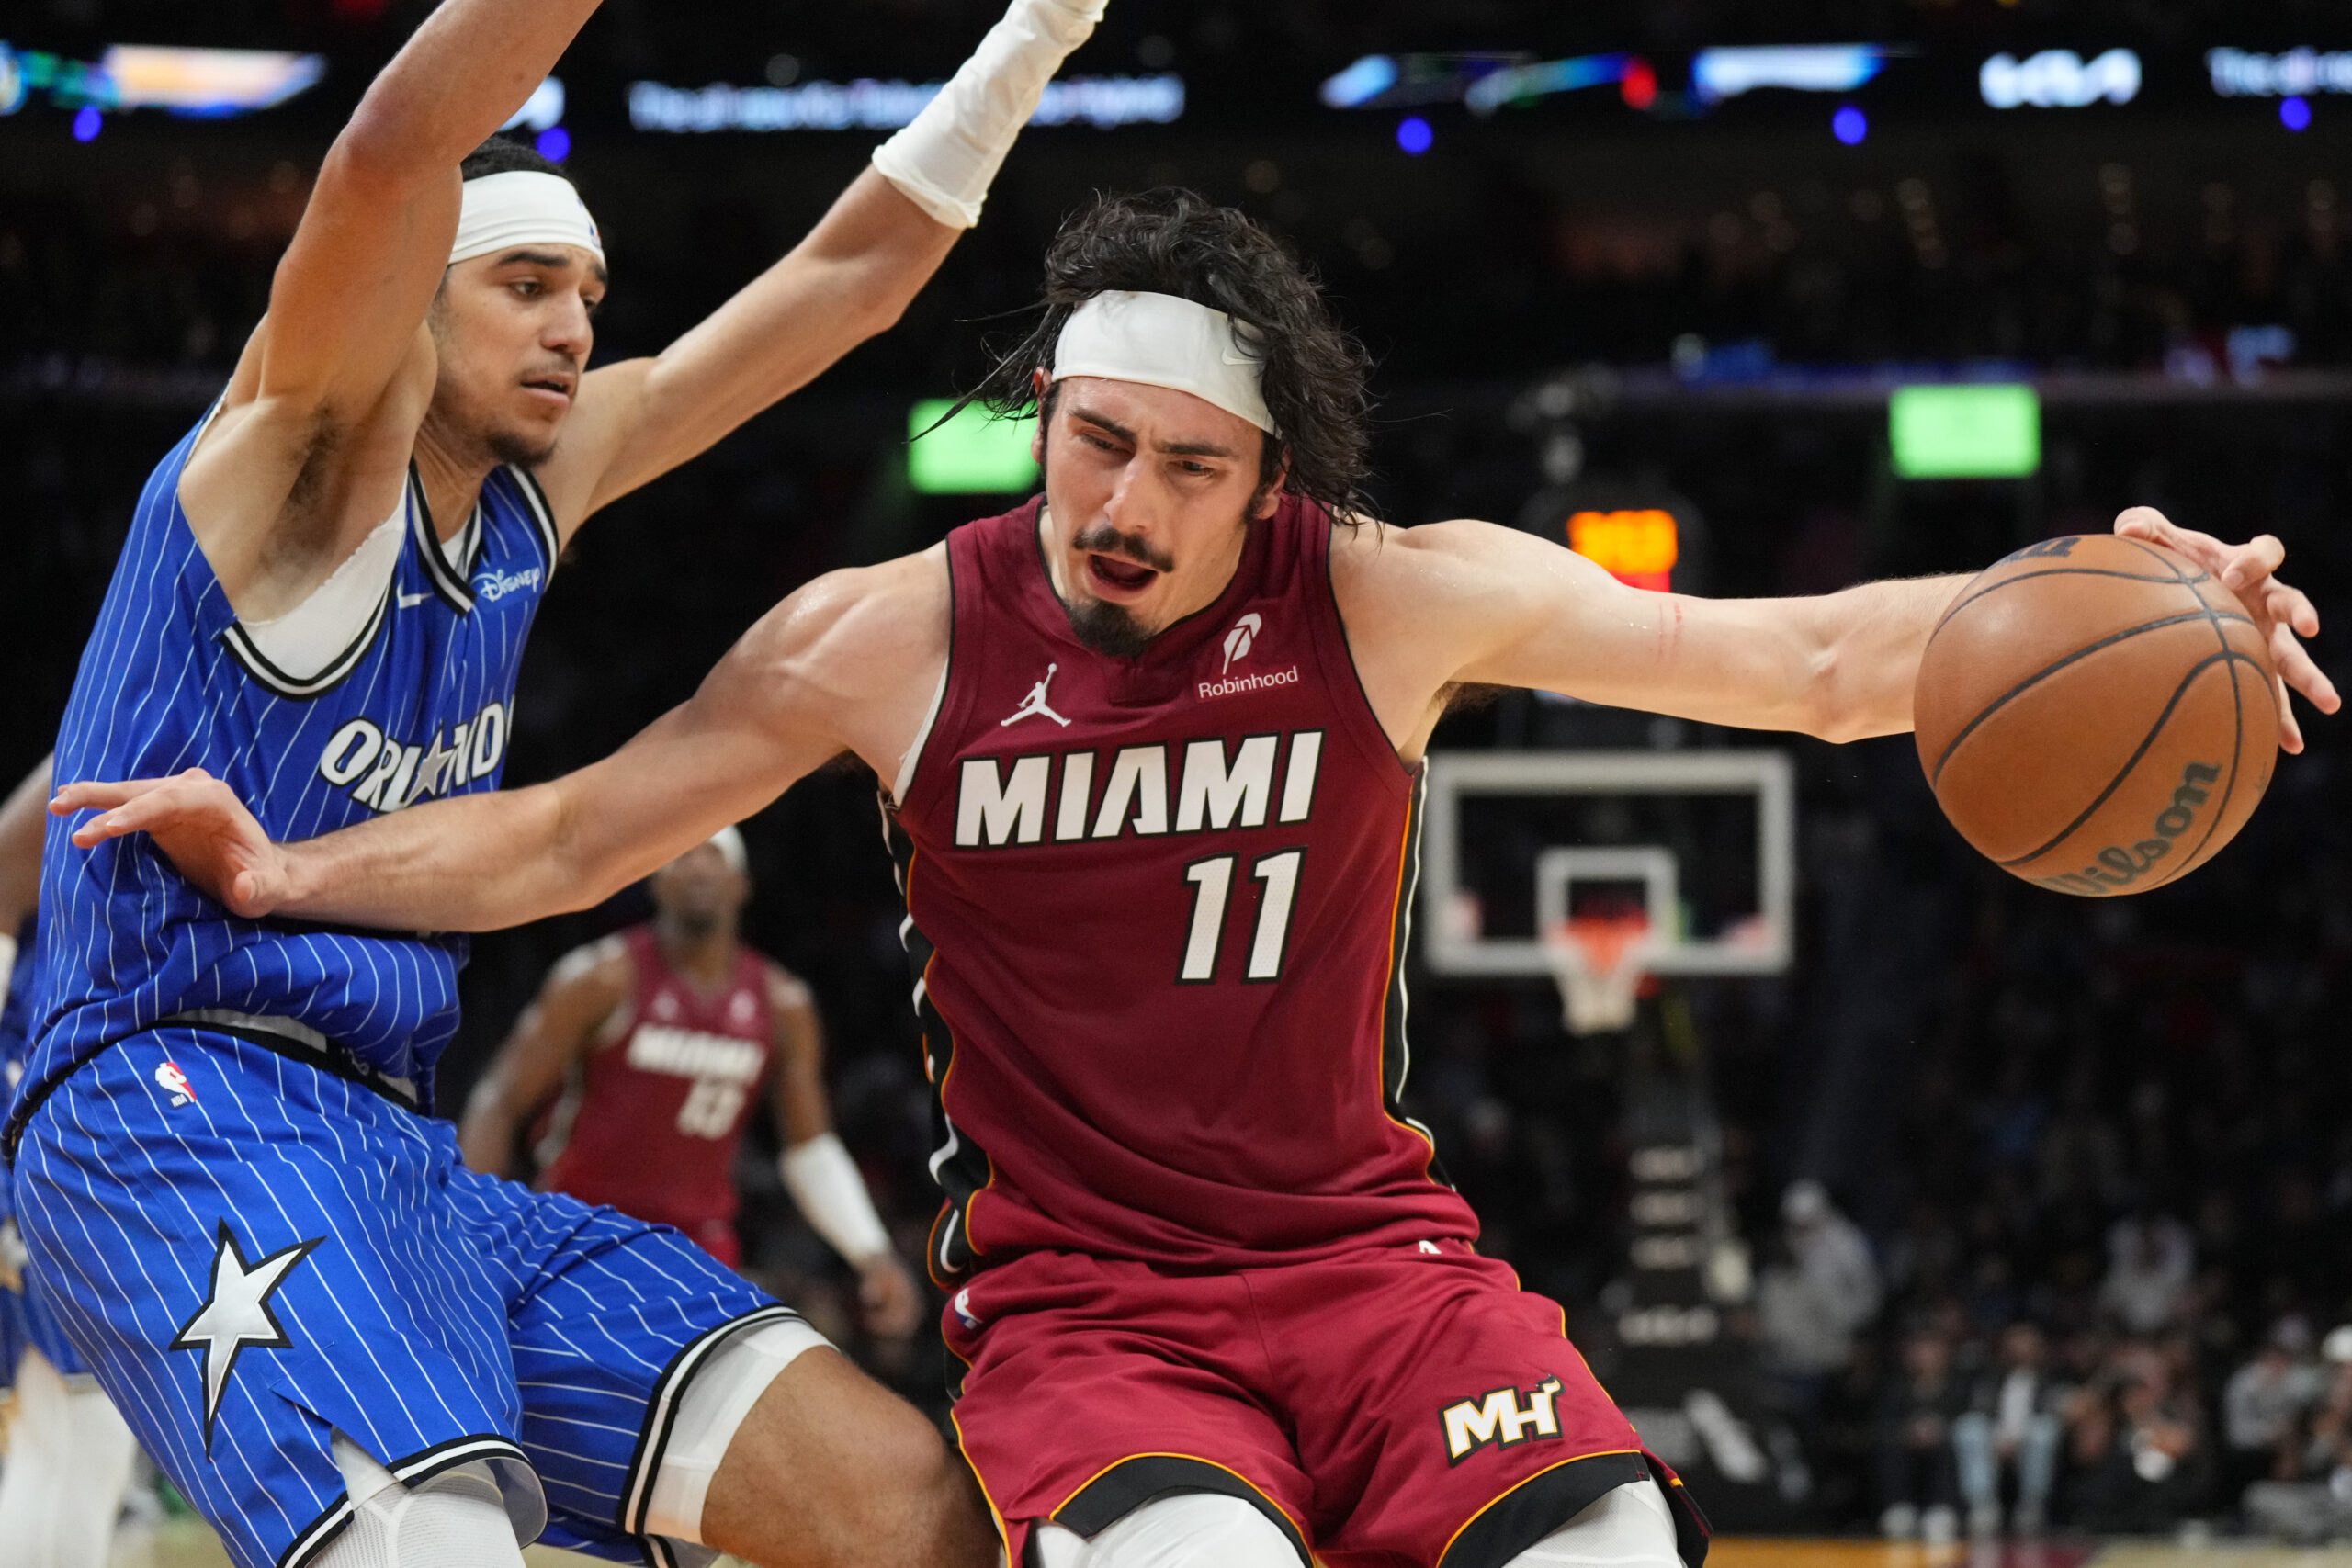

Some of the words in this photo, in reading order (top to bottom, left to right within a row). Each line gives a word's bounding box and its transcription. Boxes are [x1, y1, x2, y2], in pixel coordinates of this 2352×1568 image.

[1198, 665, 1299, 700] Robinhood
[319, 694, 514, 812] ORLAND
[954, 729, 1324, 848] MIAMI
[1177, 848, 1306, 983] 11
